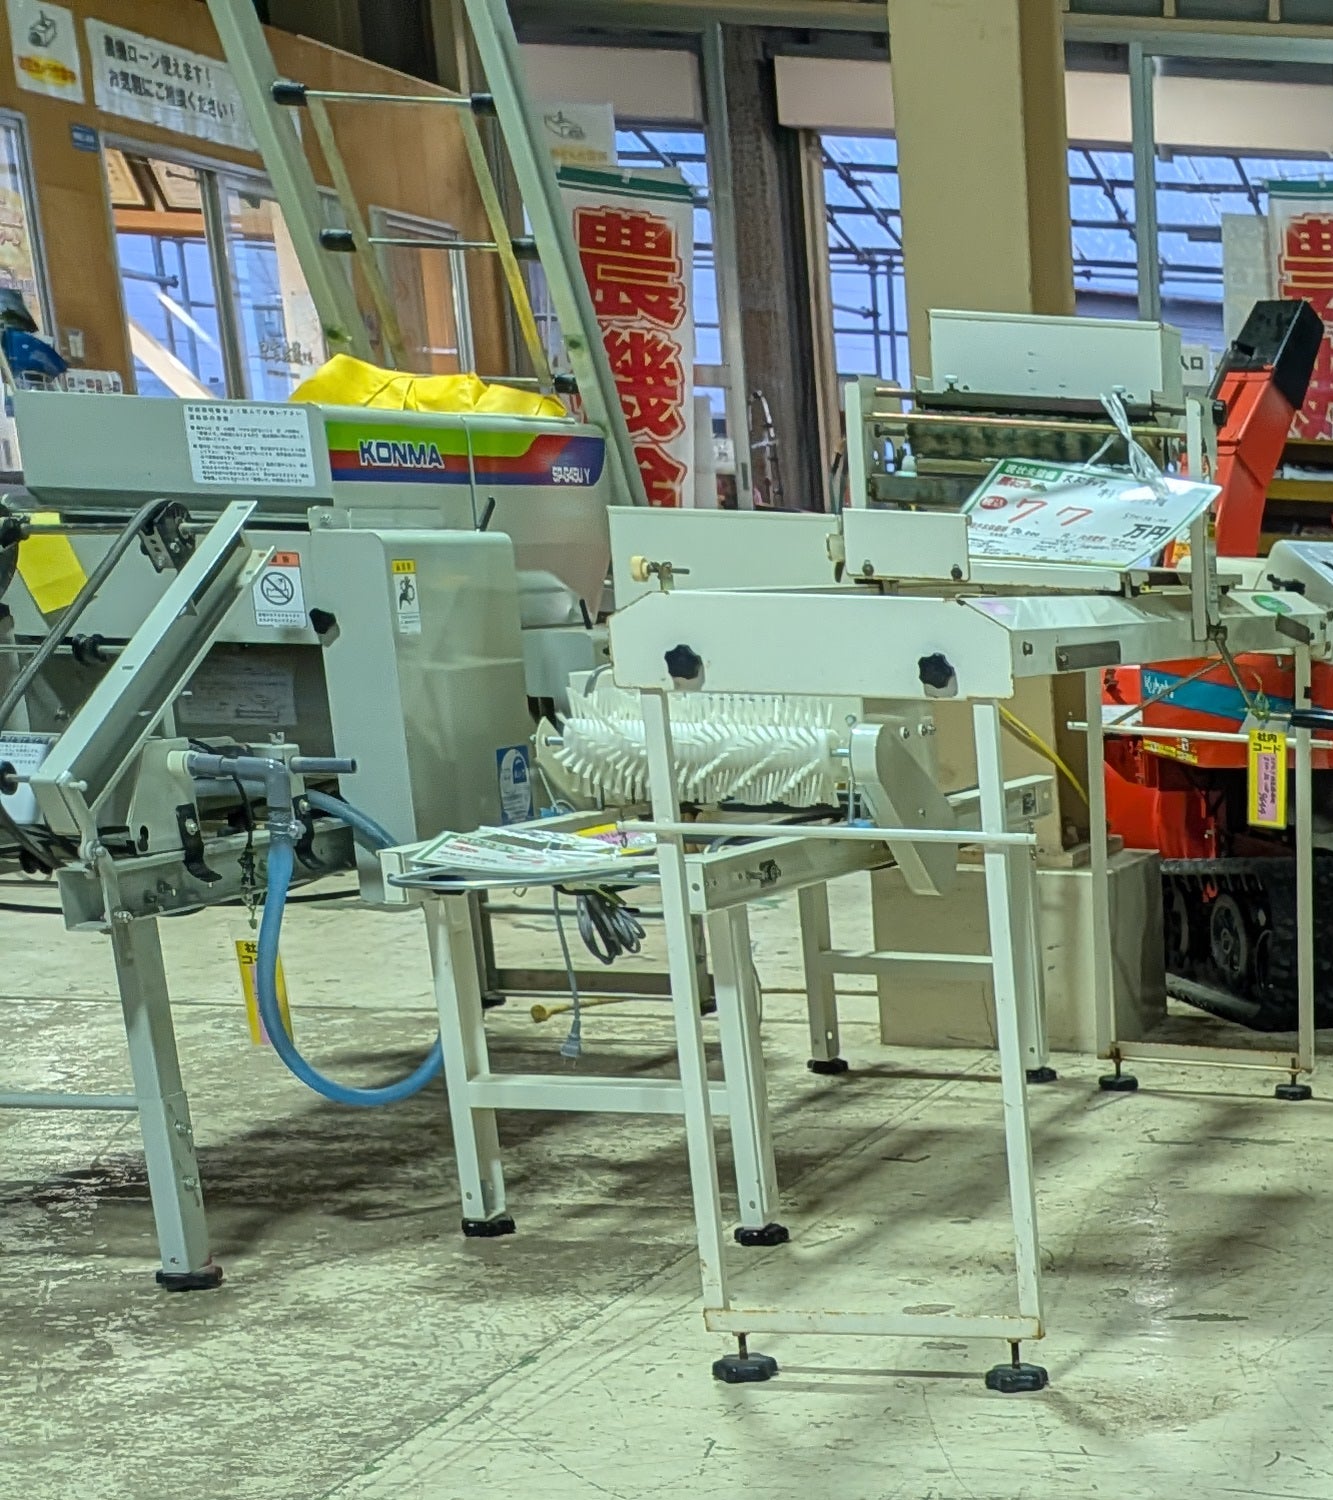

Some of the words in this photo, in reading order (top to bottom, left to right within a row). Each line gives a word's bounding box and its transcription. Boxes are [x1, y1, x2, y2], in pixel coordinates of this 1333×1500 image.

[359, 440, 446, 469] KONMA
[1122, 523, 1172, 541] 万円
[1257, 732, 1278, 744] 社内
[1252, 742, 1282, 754] コード
